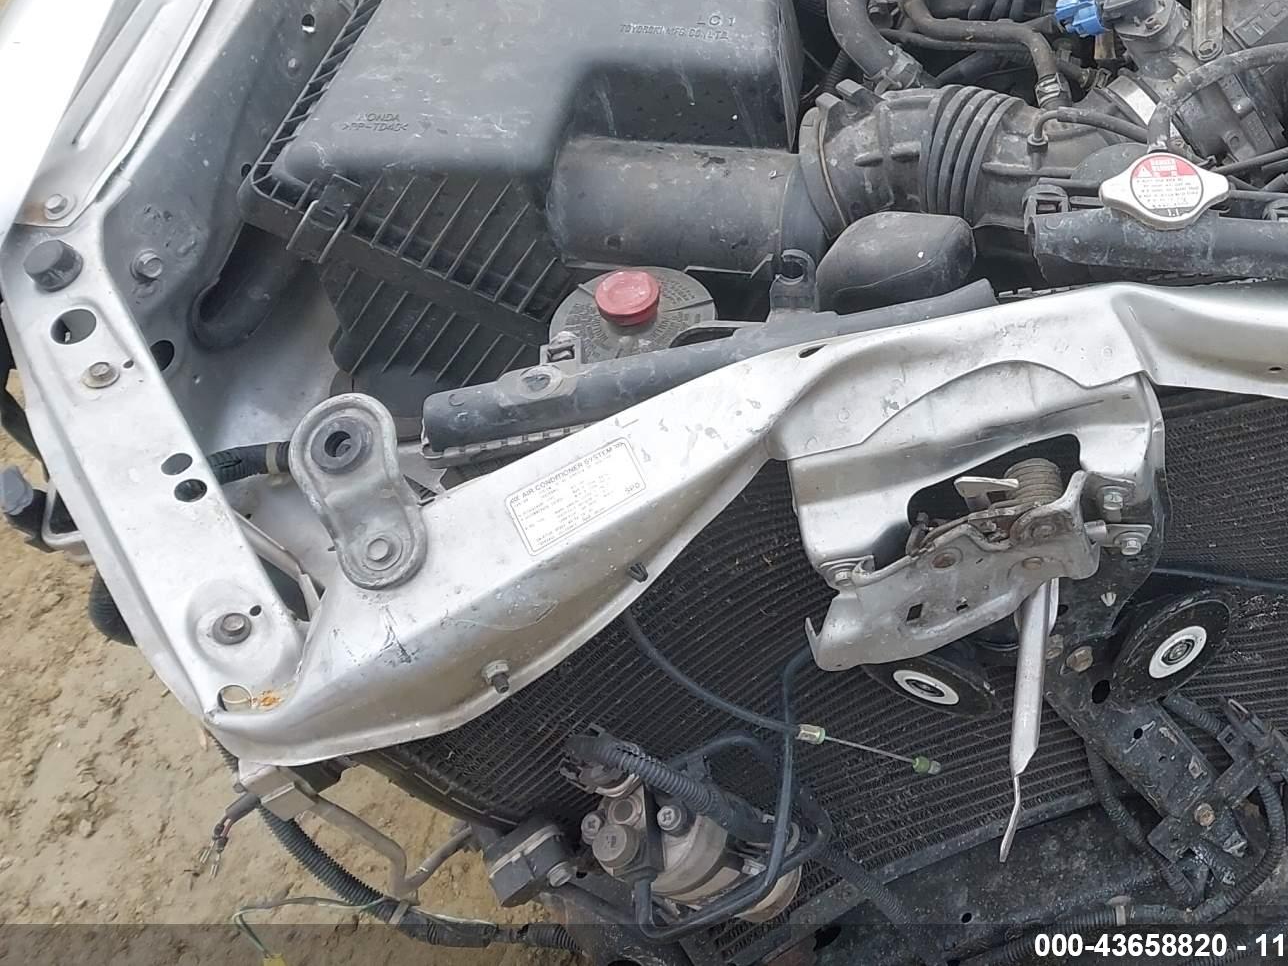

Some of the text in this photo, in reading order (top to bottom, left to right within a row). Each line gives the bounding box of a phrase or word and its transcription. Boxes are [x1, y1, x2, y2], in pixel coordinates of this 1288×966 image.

[359, 113, 401, 122] HONDA
[522, 446, 613, 498] AIR CONDITIONER SYSTEM
